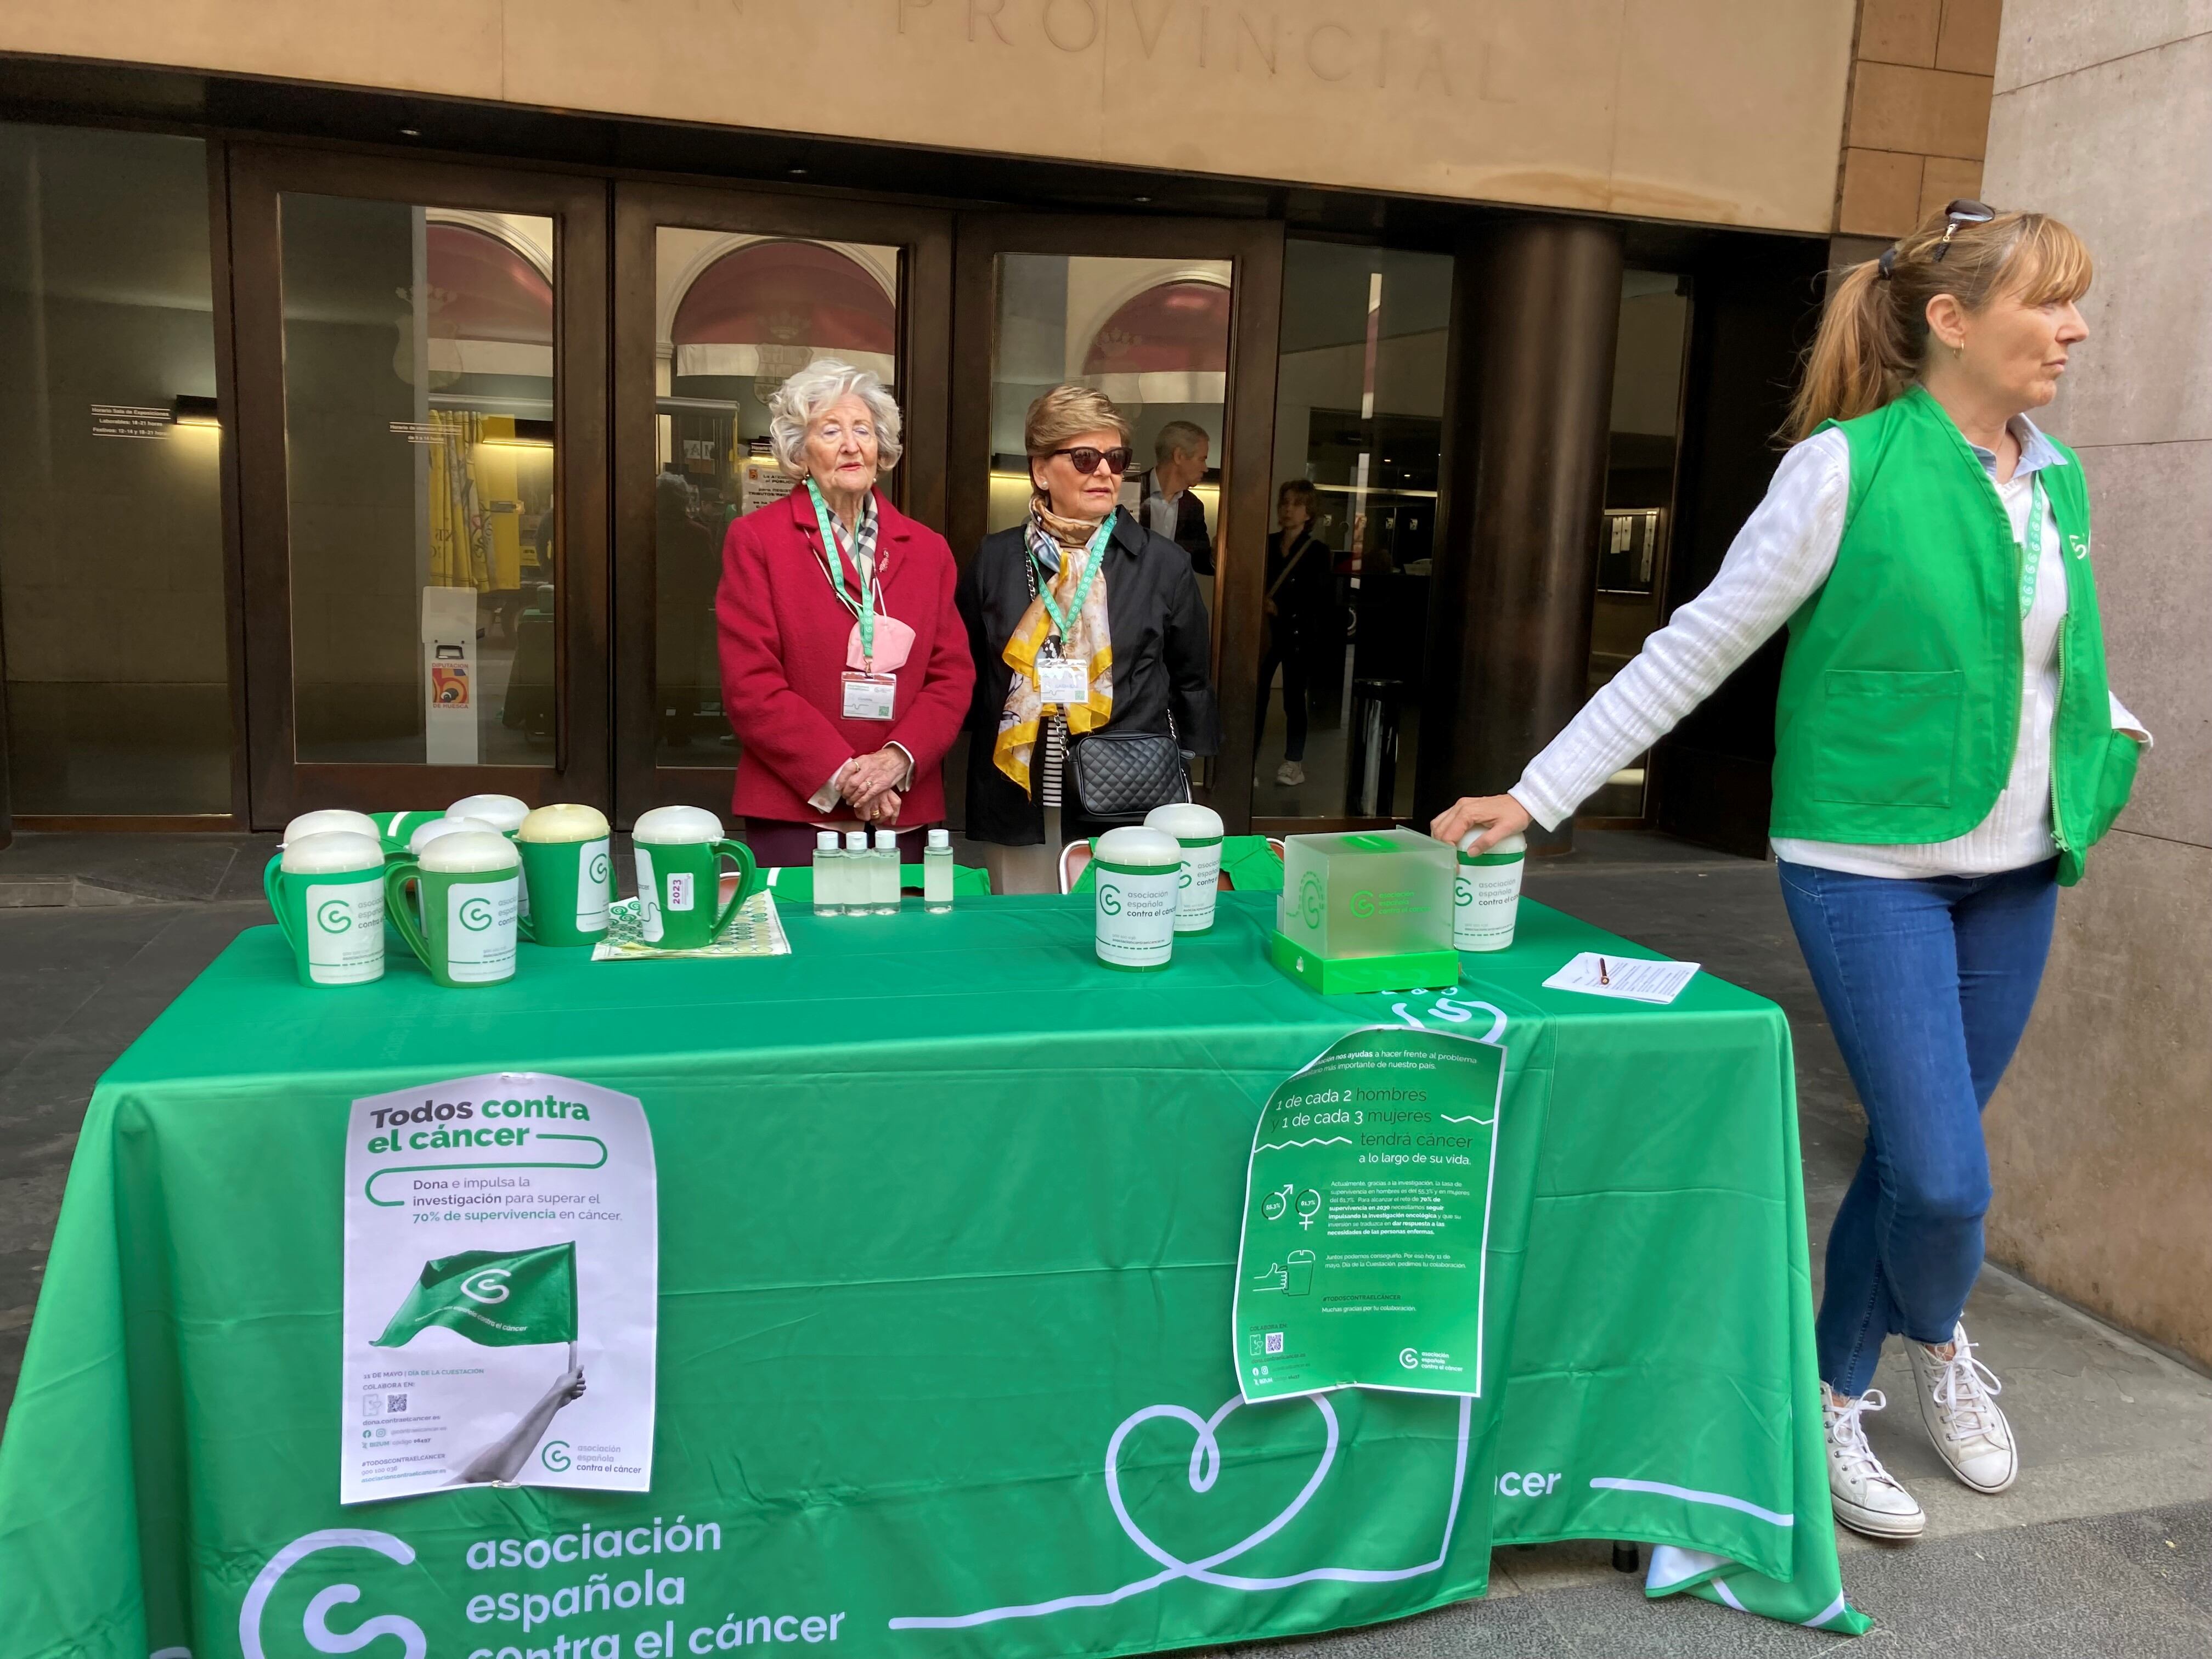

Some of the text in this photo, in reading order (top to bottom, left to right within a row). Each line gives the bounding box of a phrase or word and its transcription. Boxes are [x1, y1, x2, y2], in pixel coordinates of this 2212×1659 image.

[1198, 859, 1220, 869] asociac
[1197, 868, 1219, 878] español
[1479, 878, 1516, 888] asociación
[673, 879, 681, 904] 2023
[1127, 890, 1169, 899] asociación
[1479, 888, 1512, 898] española
[358, 896, 383, 909] asocia
[498, 895, 517, 906] asoci
[1127, 900, 1164, 910] española
[498, 906, 517, 916] españ
[1127, 910, 1153, 918] contra
[498, 915, 517, 926] contr
[1347, 1050, 1373, 1060] ayudas
[1381, 1049, 1403, 1058] hacer
[1403, 1050, 1427, 1059] frente
[1429, 1051, 1437, 1059] al
[1437, 1052, 1477, 1064] problema
[1338, 1061, 1376, 1070] importante
[1376, 1060, 1387, 1068] de
[1419, 1060, 1436, 1070] país.
[1276, 1087, 1427, 1111] 1 de cada 2 hombres
[370, 1094, 590, 1129] Todos contra
[1282, 1108, 1432, 1128] 1 de cada 3 mujeres
[367, 1124, 531, 1154] el cáncer
[1360, 1131, 1473, 1149] tendrá cáncer
[1358, 1153, 1472, 1166] a lo largo de su vida.
[413, 1176, 531, 1190] Dona e impulsa la
[413, 1193, 600, 1207] investigación para superar el
[413, 1209, 623, 1224] 70% de supervivencia en cáncer.
[363, 1383, 402, 1391] COLABORA
[363, 1415, 441, 1426] dona.contraelcancer.es
[578, 1444, 622, 1453] asociación
[577, 1454, 614, 1463] española
[577, 1464, 642, 1474] contra el cáncer
[1499, 1471, 1562, 1497] cer
[466, 1515, 721, 1570] asociación
[466, 1568, 686, 1633] española
[634, 1620, 675, 1659] el
[688, 1611, 846, 1655] cáncer
